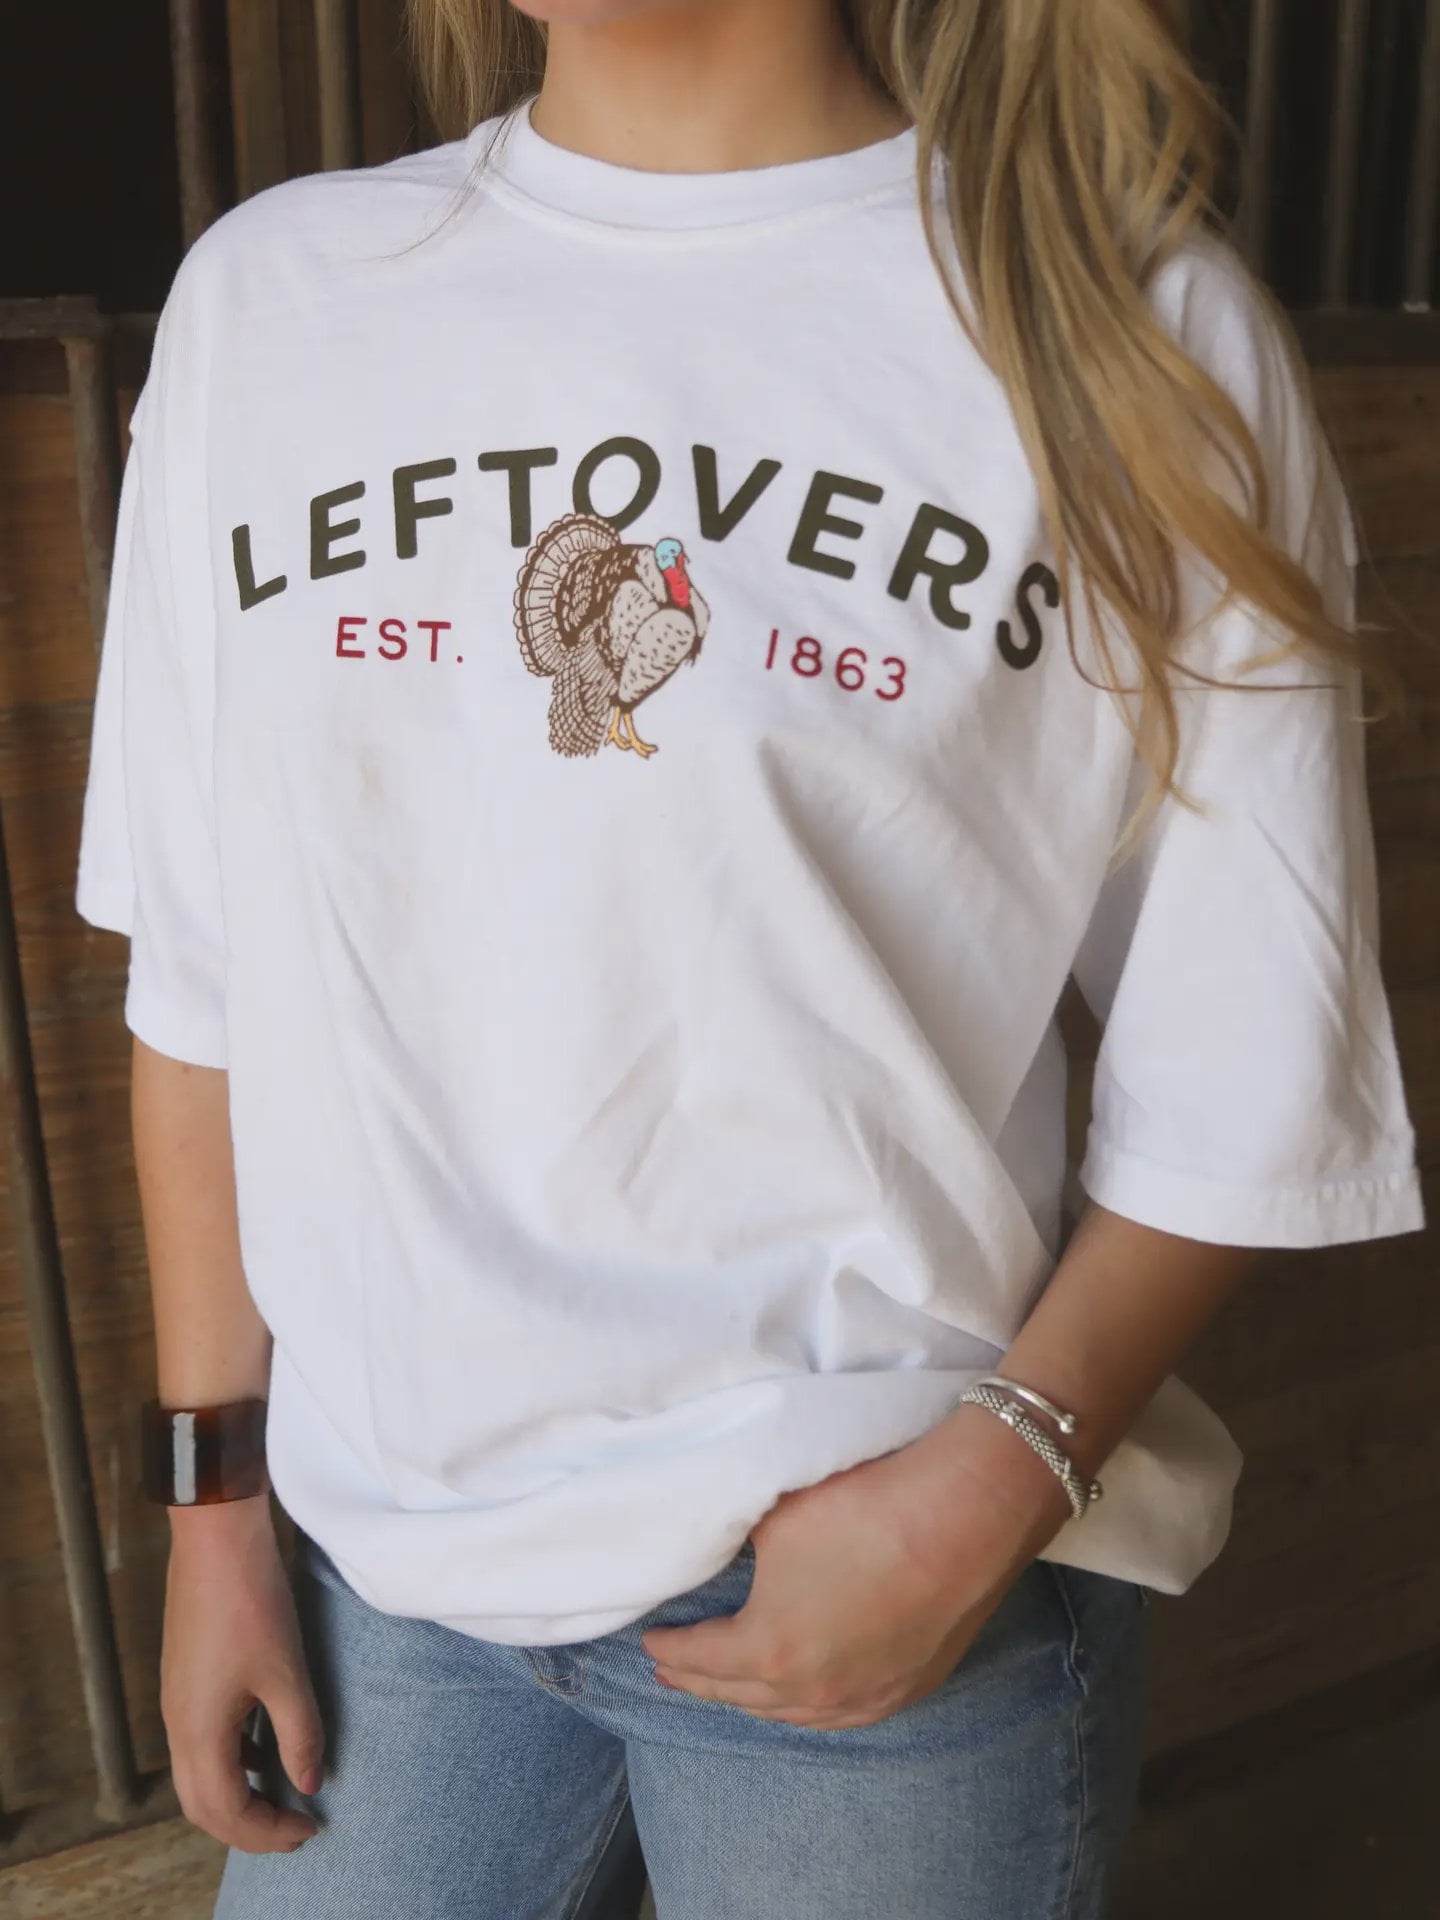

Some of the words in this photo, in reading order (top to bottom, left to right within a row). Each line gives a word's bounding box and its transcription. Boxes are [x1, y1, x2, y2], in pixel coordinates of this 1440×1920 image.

[231, 435, 1060, 671] LEFTOVERS
[335, 616, 465, 665] EST.
[765, 628, 910, 702] 1863
